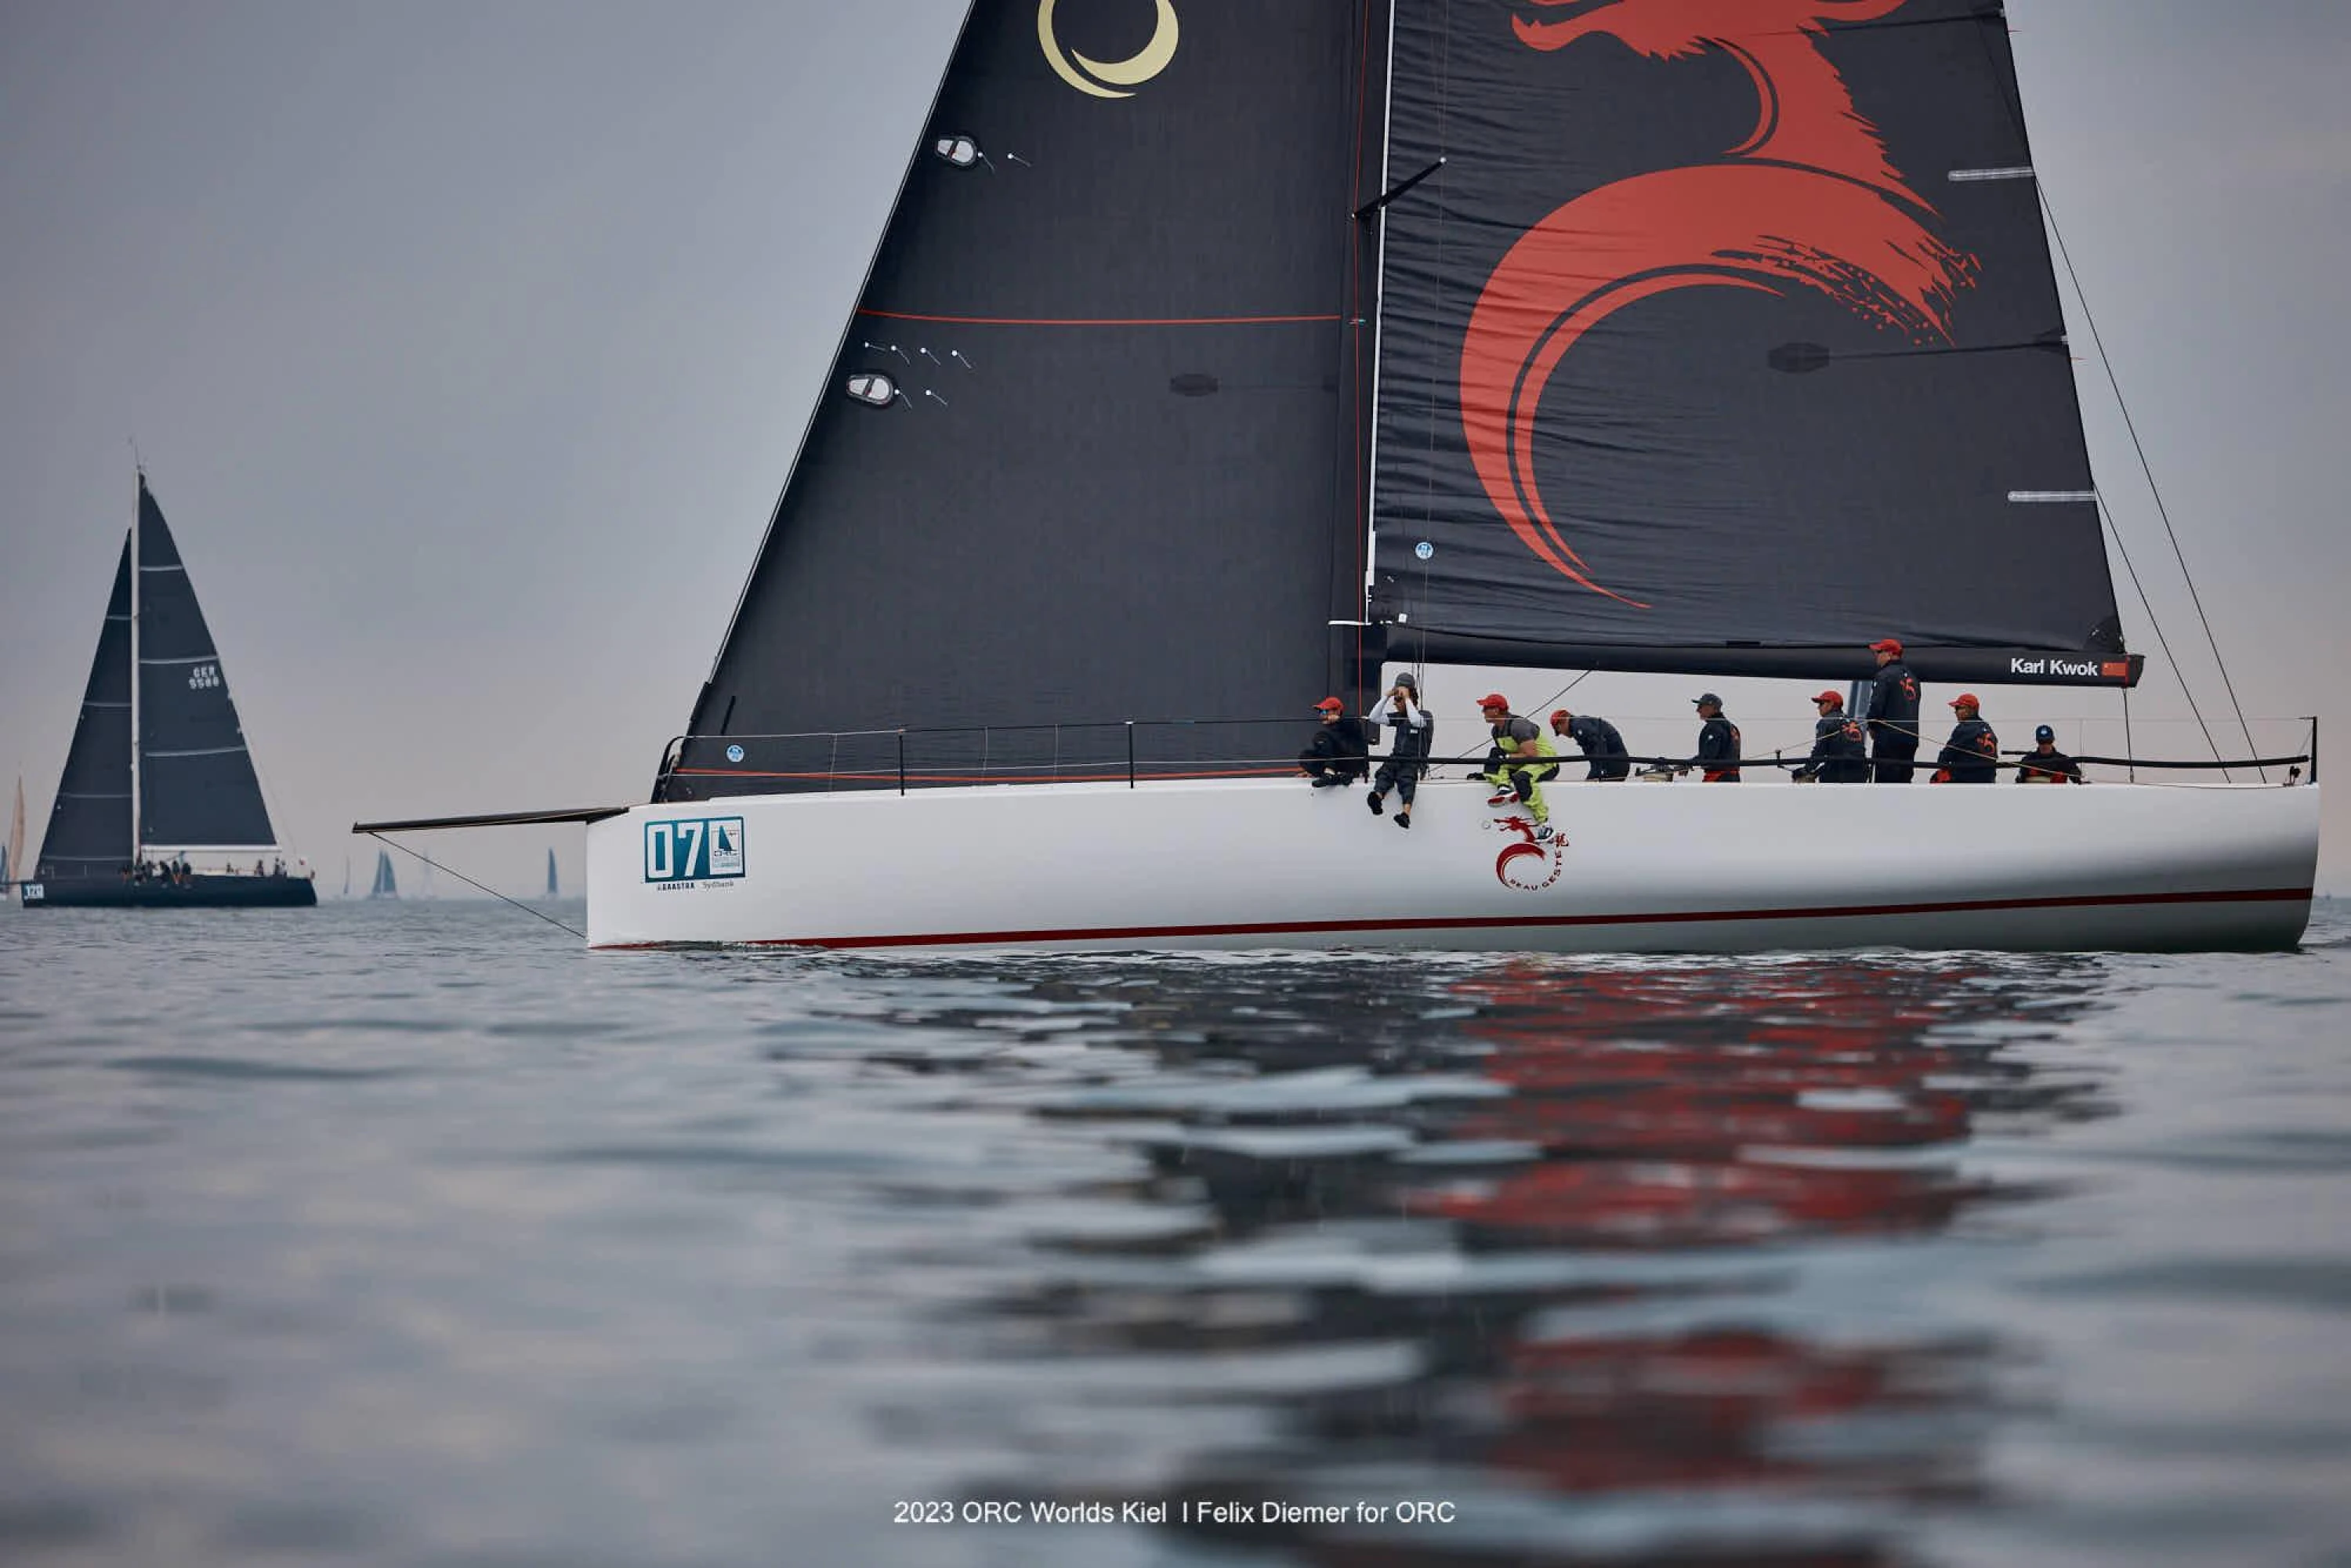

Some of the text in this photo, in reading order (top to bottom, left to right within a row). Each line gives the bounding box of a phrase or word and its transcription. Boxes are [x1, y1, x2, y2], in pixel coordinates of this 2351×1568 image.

[2011, 658, 2098, 676] Karl Kwok
[647, 823, 704, 878] 07
[1541, 850, 1562, 888] GESTE
